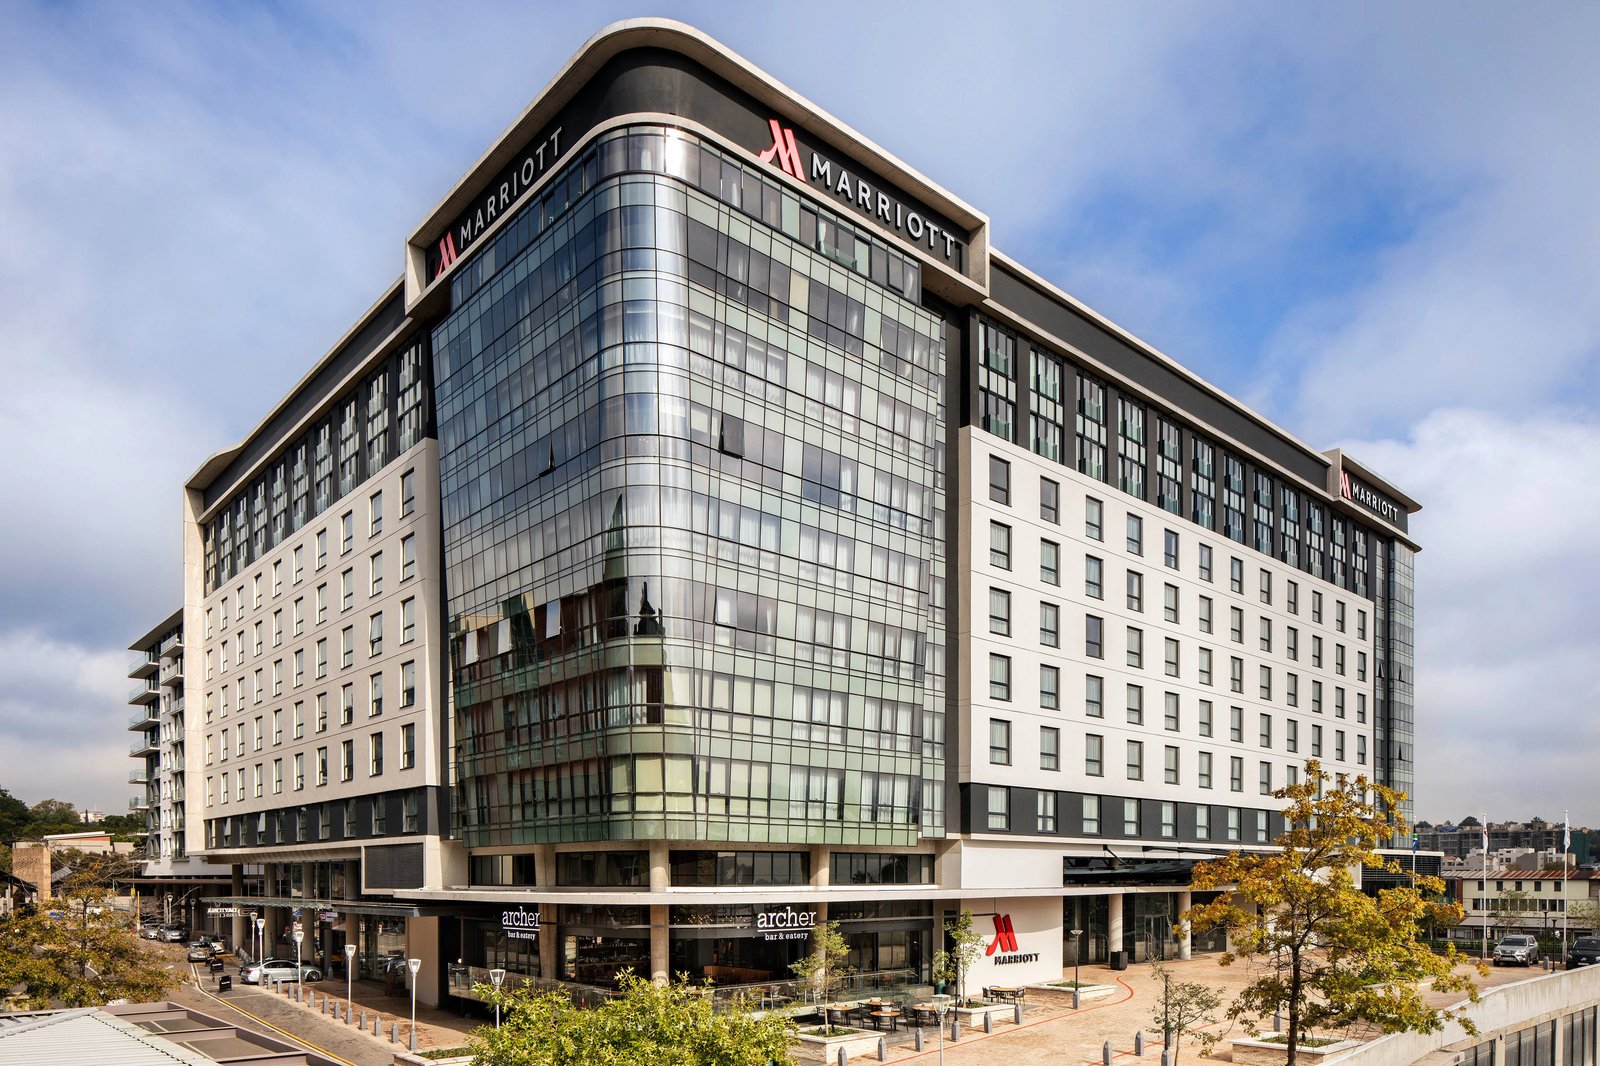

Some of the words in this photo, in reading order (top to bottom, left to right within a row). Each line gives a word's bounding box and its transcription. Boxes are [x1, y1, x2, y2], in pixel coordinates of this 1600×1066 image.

[460, 126, 562, 249] MARRIOTT
[811, 152, 955, 258] MARRIOTT
[1352, 482, 1398, 522] MARRIOTT
[502, 906, 541, 926] archer
[757, 906, 816, 928] archer
[778, 932, 785, 940] &
[994, 953, 1040, 966] MARRIOTT
